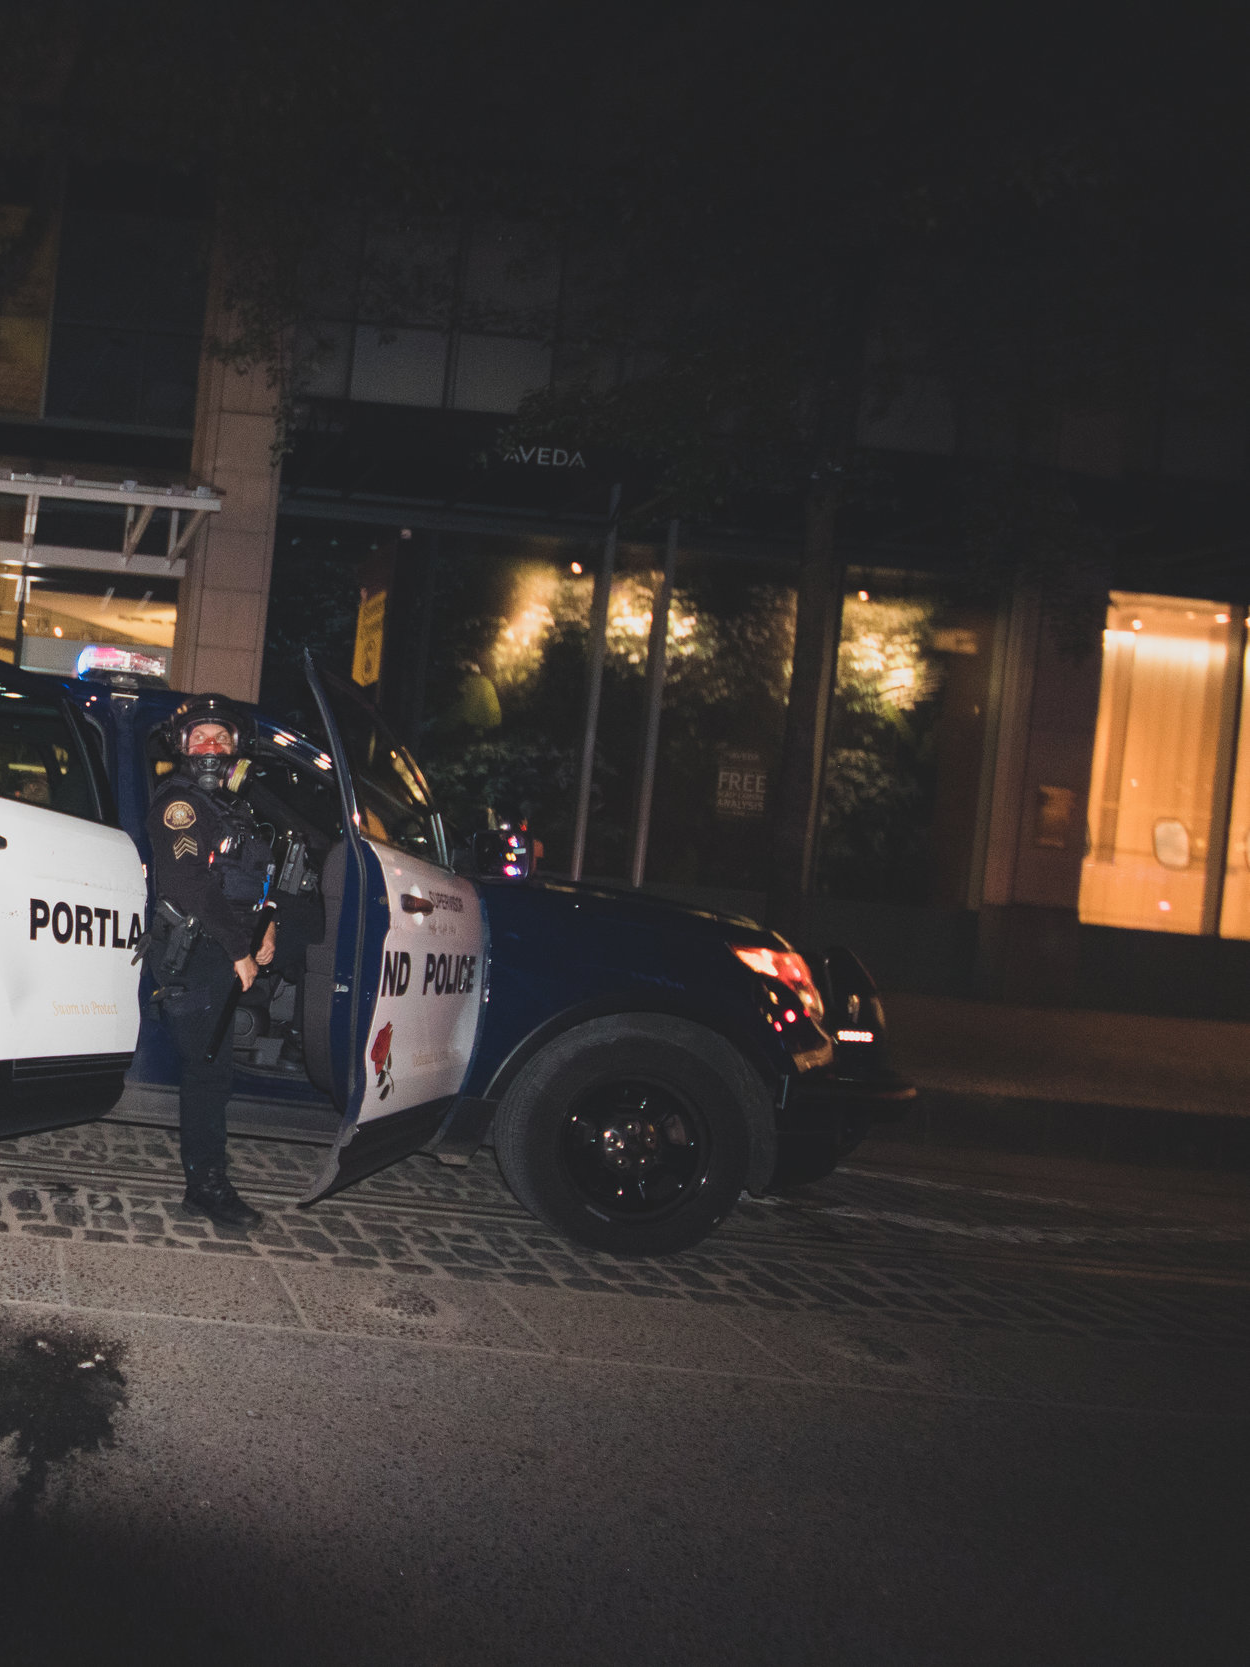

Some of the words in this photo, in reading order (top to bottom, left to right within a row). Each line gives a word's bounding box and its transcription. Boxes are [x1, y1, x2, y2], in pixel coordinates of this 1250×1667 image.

[502, 444, 587, 469] AVEDA
[717, 771, 767, 794] FREE
[30, 898, 143, 950] PORTLA
[381, 951, 411, 997] ND
[422, 953, 477, 996] POLICE
